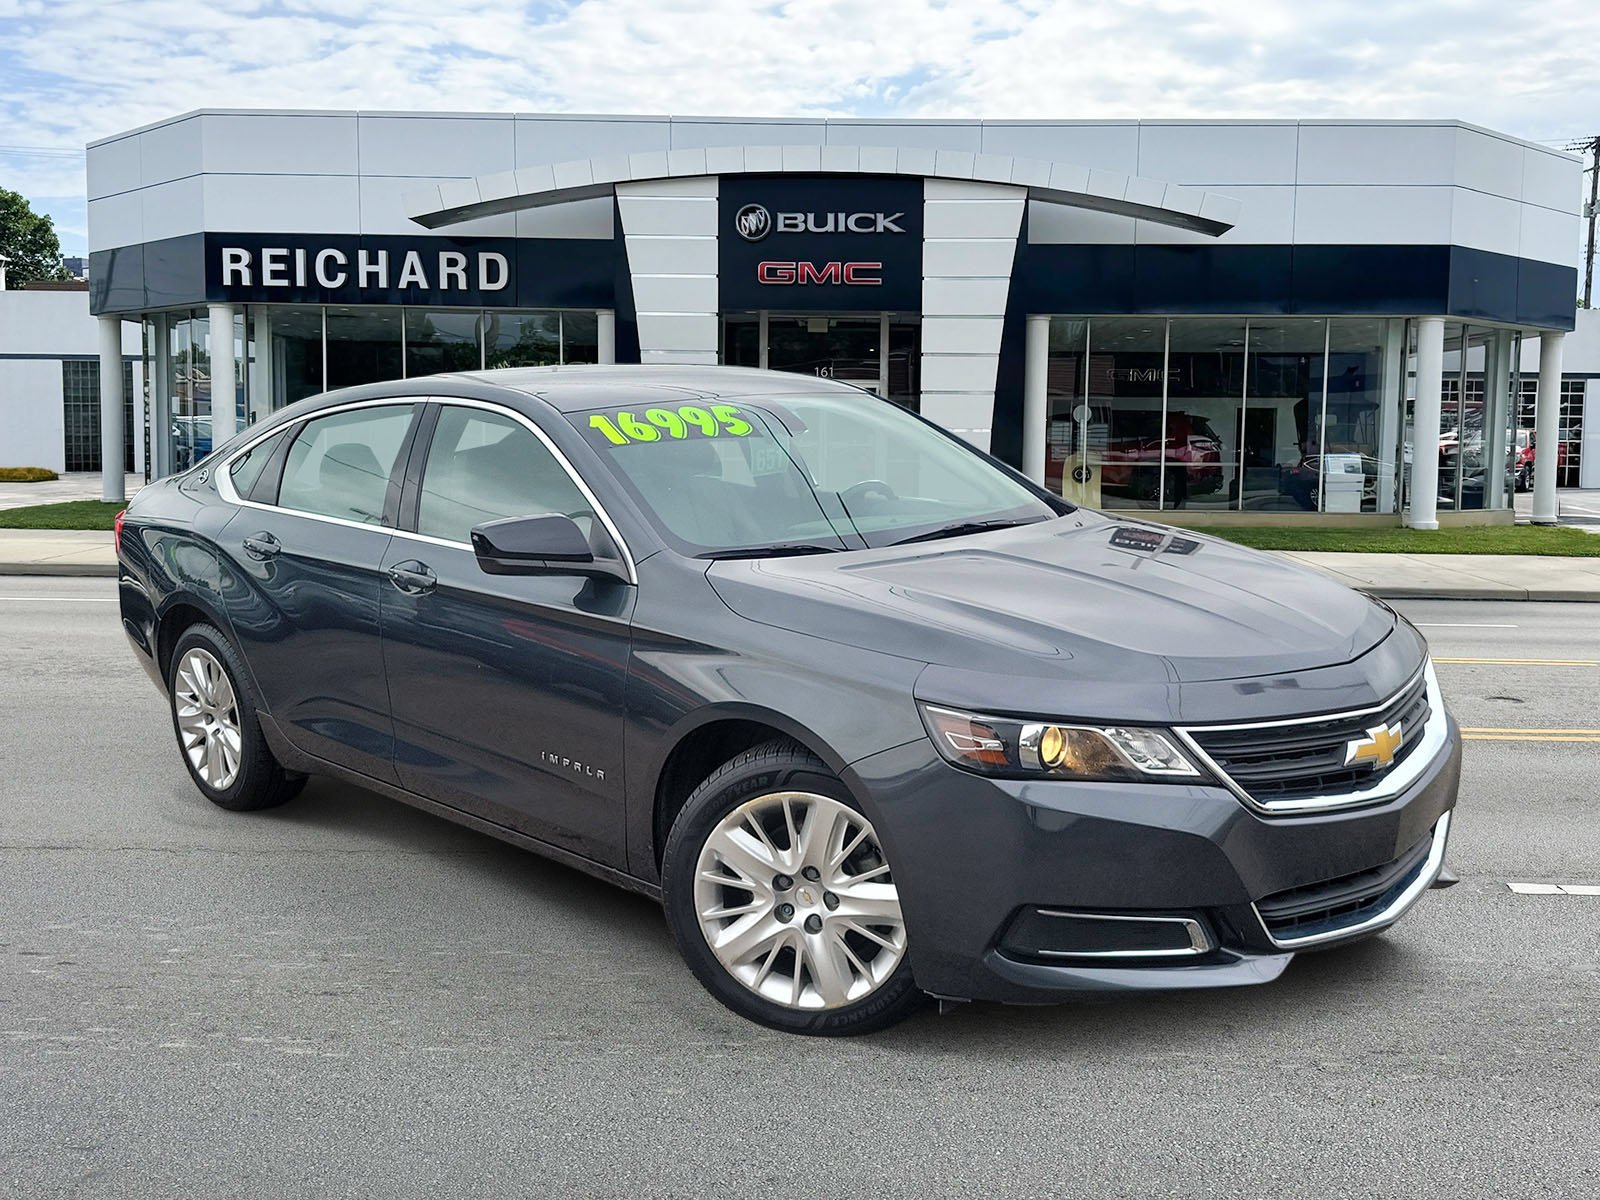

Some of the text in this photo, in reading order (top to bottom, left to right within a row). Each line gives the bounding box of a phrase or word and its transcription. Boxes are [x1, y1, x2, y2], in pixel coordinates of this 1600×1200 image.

[776, 212, 906, 233] BUICK
[222, 247, 509, 291] REICHARD
[757, 261, 882, 285] GMC
[814, 366, 834, 377] 161
[589, 405, 753, 445] 16995
[540, 751, 606, 780] IMPALA
